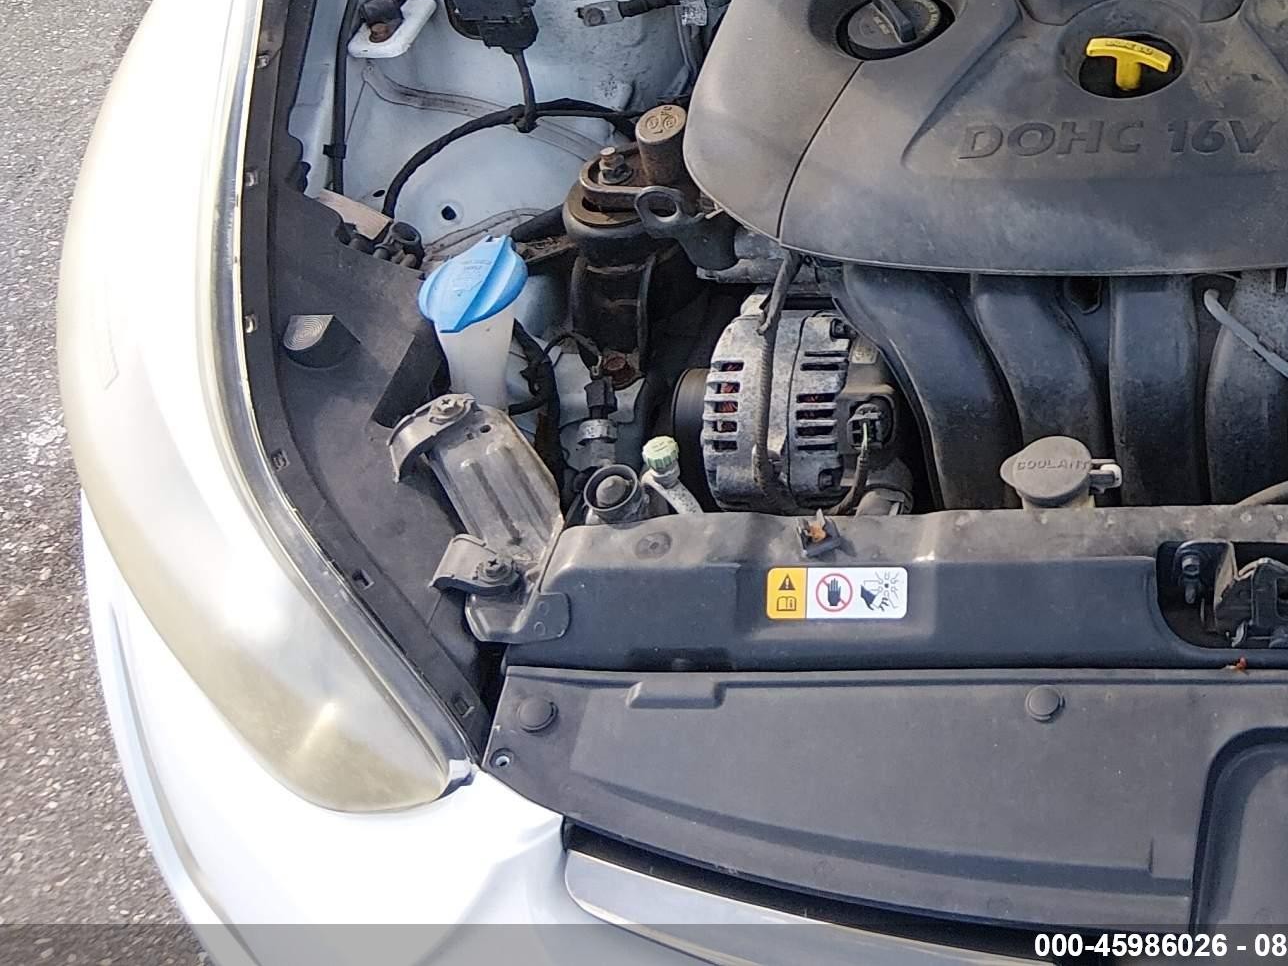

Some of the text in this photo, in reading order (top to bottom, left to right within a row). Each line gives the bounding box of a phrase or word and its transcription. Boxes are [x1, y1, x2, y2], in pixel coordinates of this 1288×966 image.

[957, 119, 1276, 159] DOHC 16V
[1017, 457, 1092, 471] COOLANT
